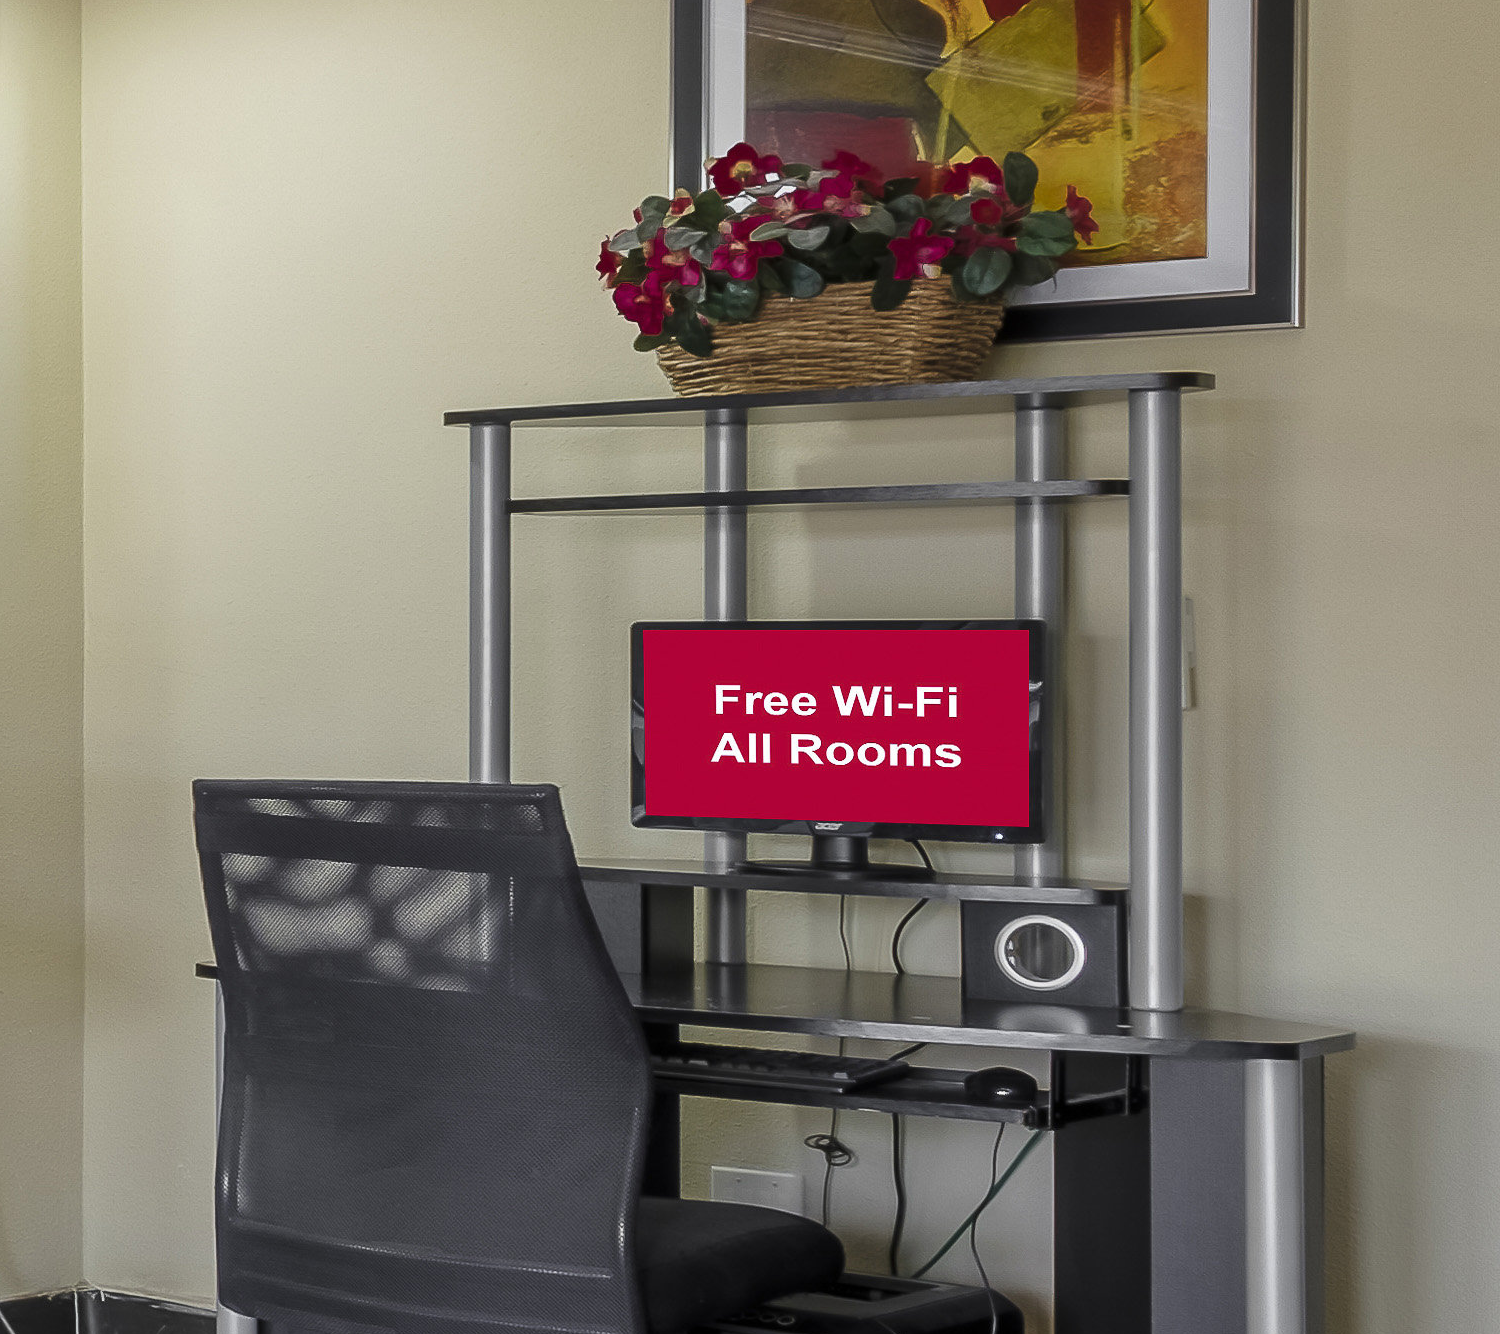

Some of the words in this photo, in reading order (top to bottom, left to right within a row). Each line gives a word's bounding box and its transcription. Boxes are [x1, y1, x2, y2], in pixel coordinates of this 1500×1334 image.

[715, 684, 817, 717] Free
[831, 685, 958, 718] Wi-Fi
[710, 732, 771, 764] All
[790, 733, 962, 768] Rooms
